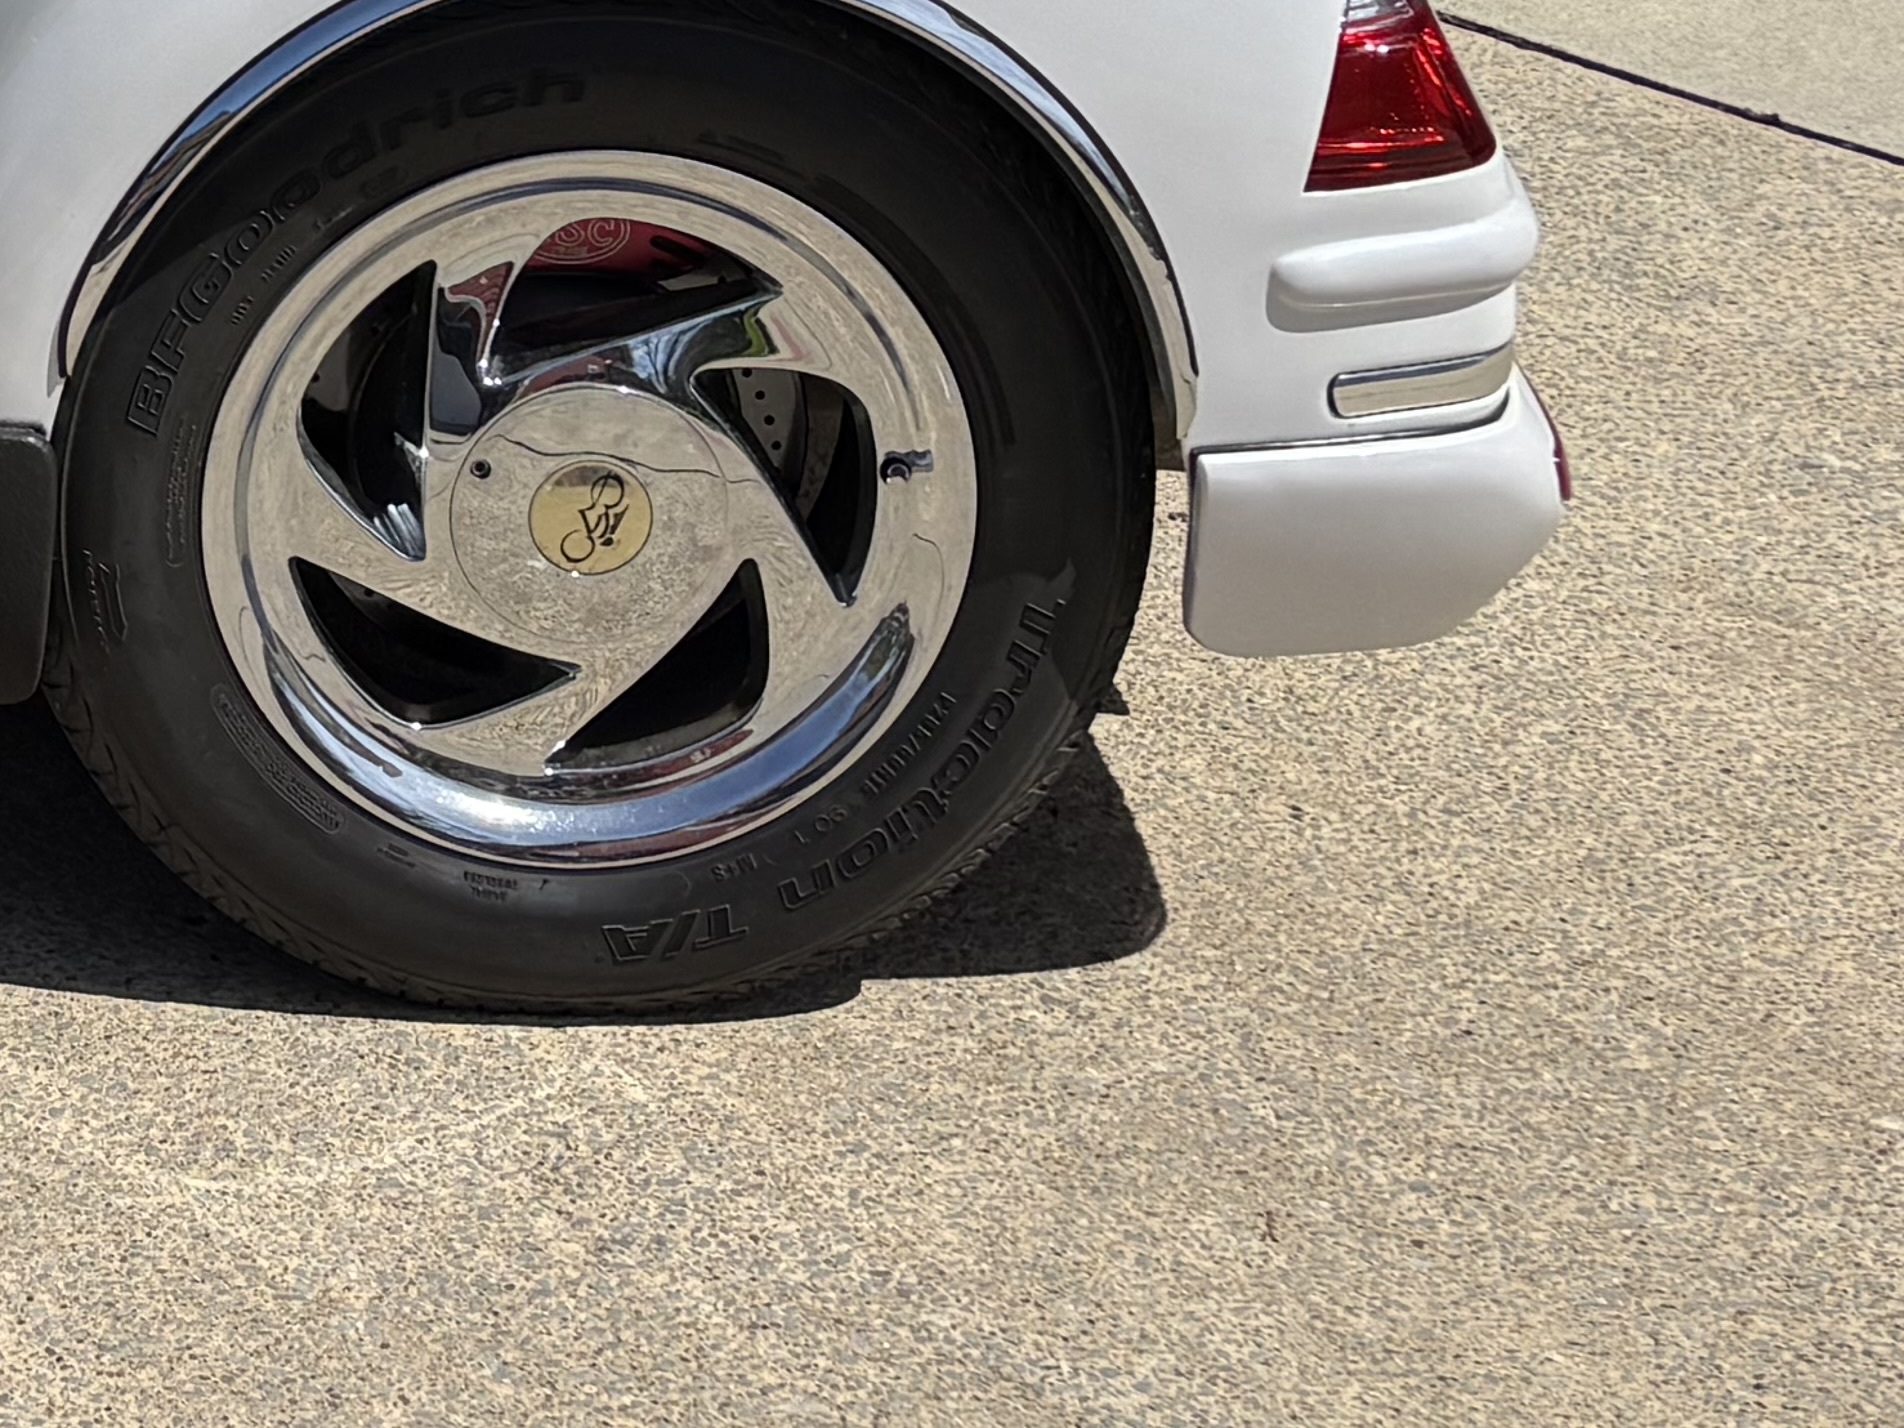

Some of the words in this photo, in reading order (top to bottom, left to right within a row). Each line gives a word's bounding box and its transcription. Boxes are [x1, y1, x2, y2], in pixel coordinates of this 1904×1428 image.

[126, 68, 583, 435] BFGoodrich
[775, 599, 1060, 915] Traction
[602, 896, 751, 965] T/A
